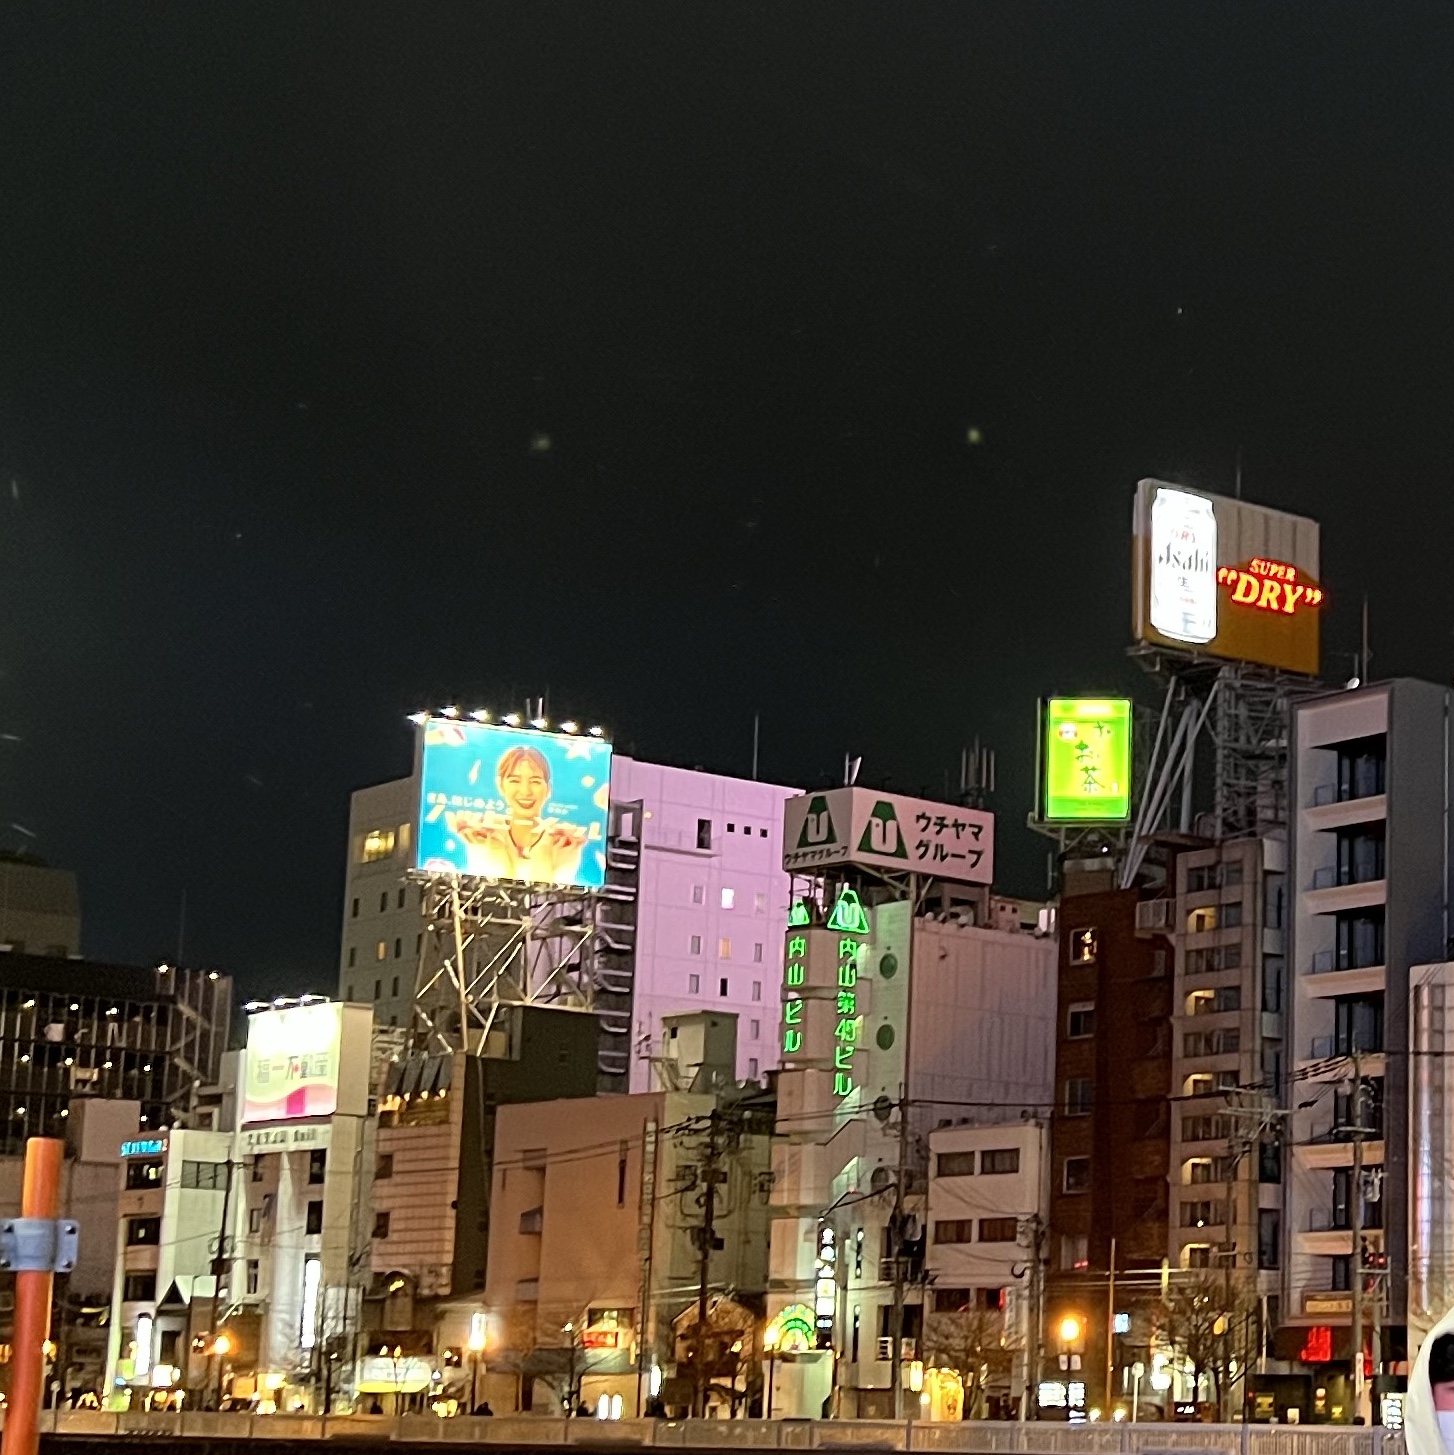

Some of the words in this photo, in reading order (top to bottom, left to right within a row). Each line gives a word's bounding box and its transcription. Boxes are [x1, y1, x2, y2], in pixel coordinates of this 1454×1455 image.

[1249, 558, 1296, 582] SUPER
[915, 811, 985, 842] ウチヤマ
[784, 845, 849, 865] ウチヤマグループ
[915, 839, 985, 869] グループ
[784, 936, 807, 1053] 内山ビル
